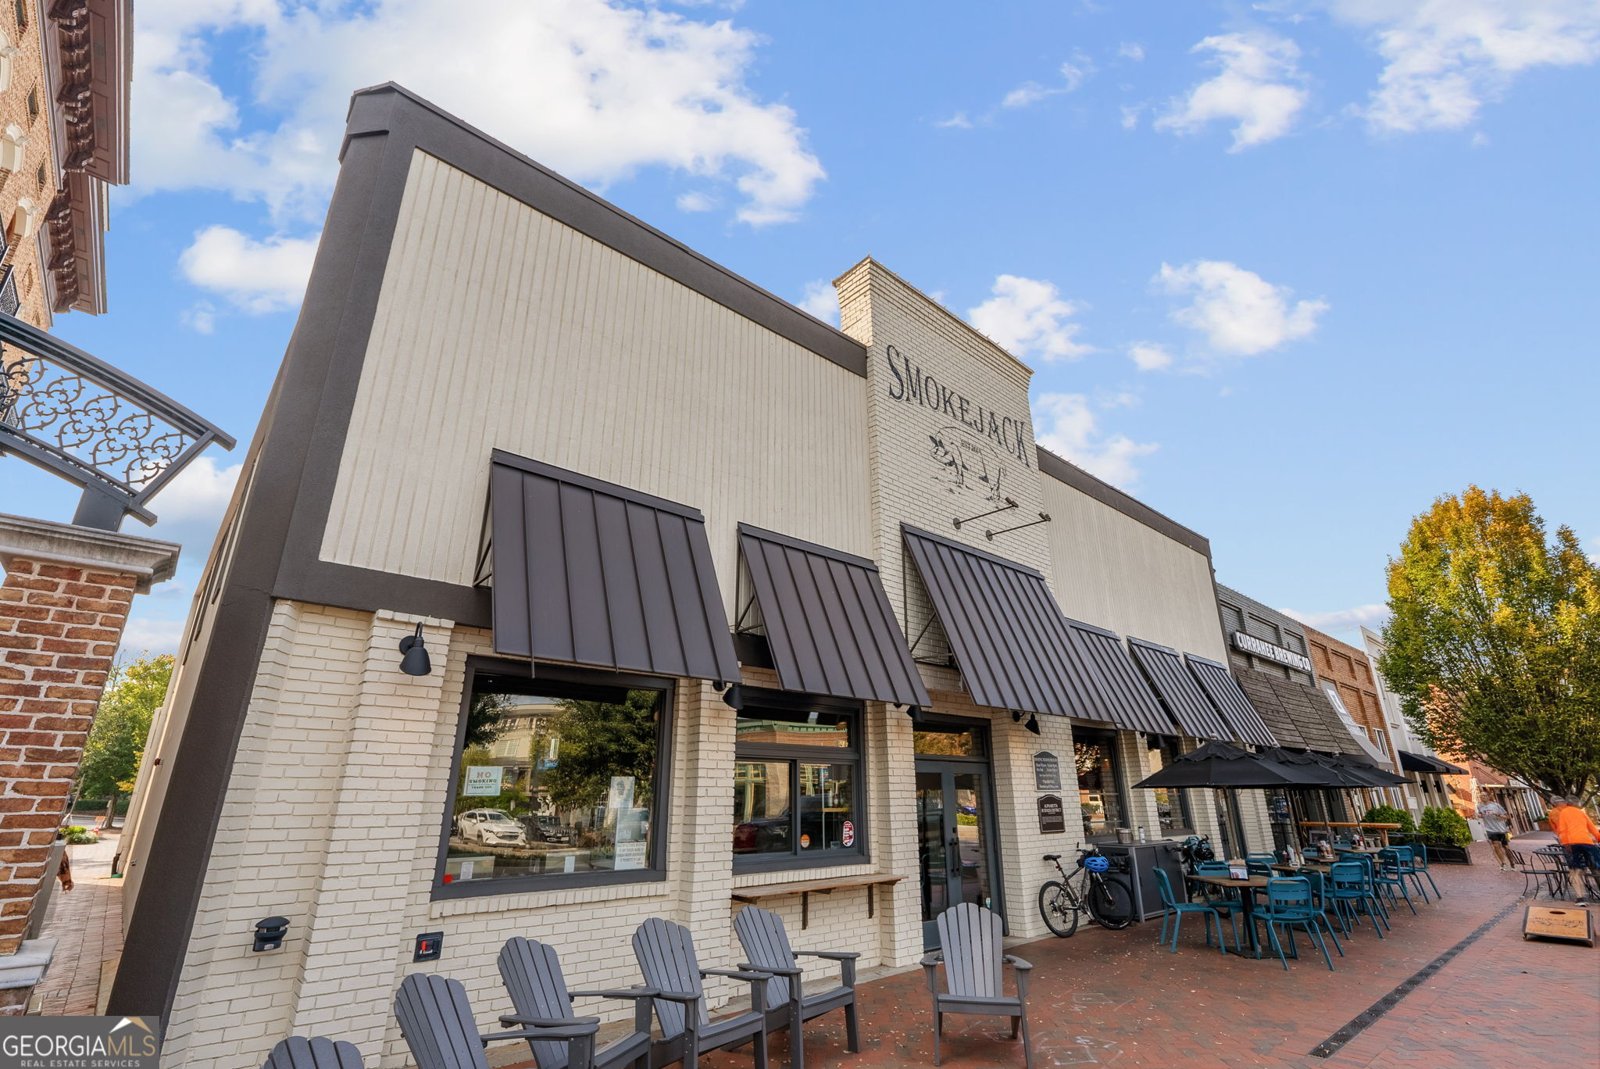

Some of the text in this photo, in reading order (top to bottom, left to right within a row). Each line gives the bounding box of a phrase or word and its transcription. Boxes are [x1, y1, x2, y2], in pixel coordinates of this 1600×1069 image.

[886, 344, 1031, 468] SMOKEJACK
[1236, 631, 1274, 660] CURRAHEE
[1273, 645, 1304, 670] BREWING
[476, 771, 492, 779] NO
